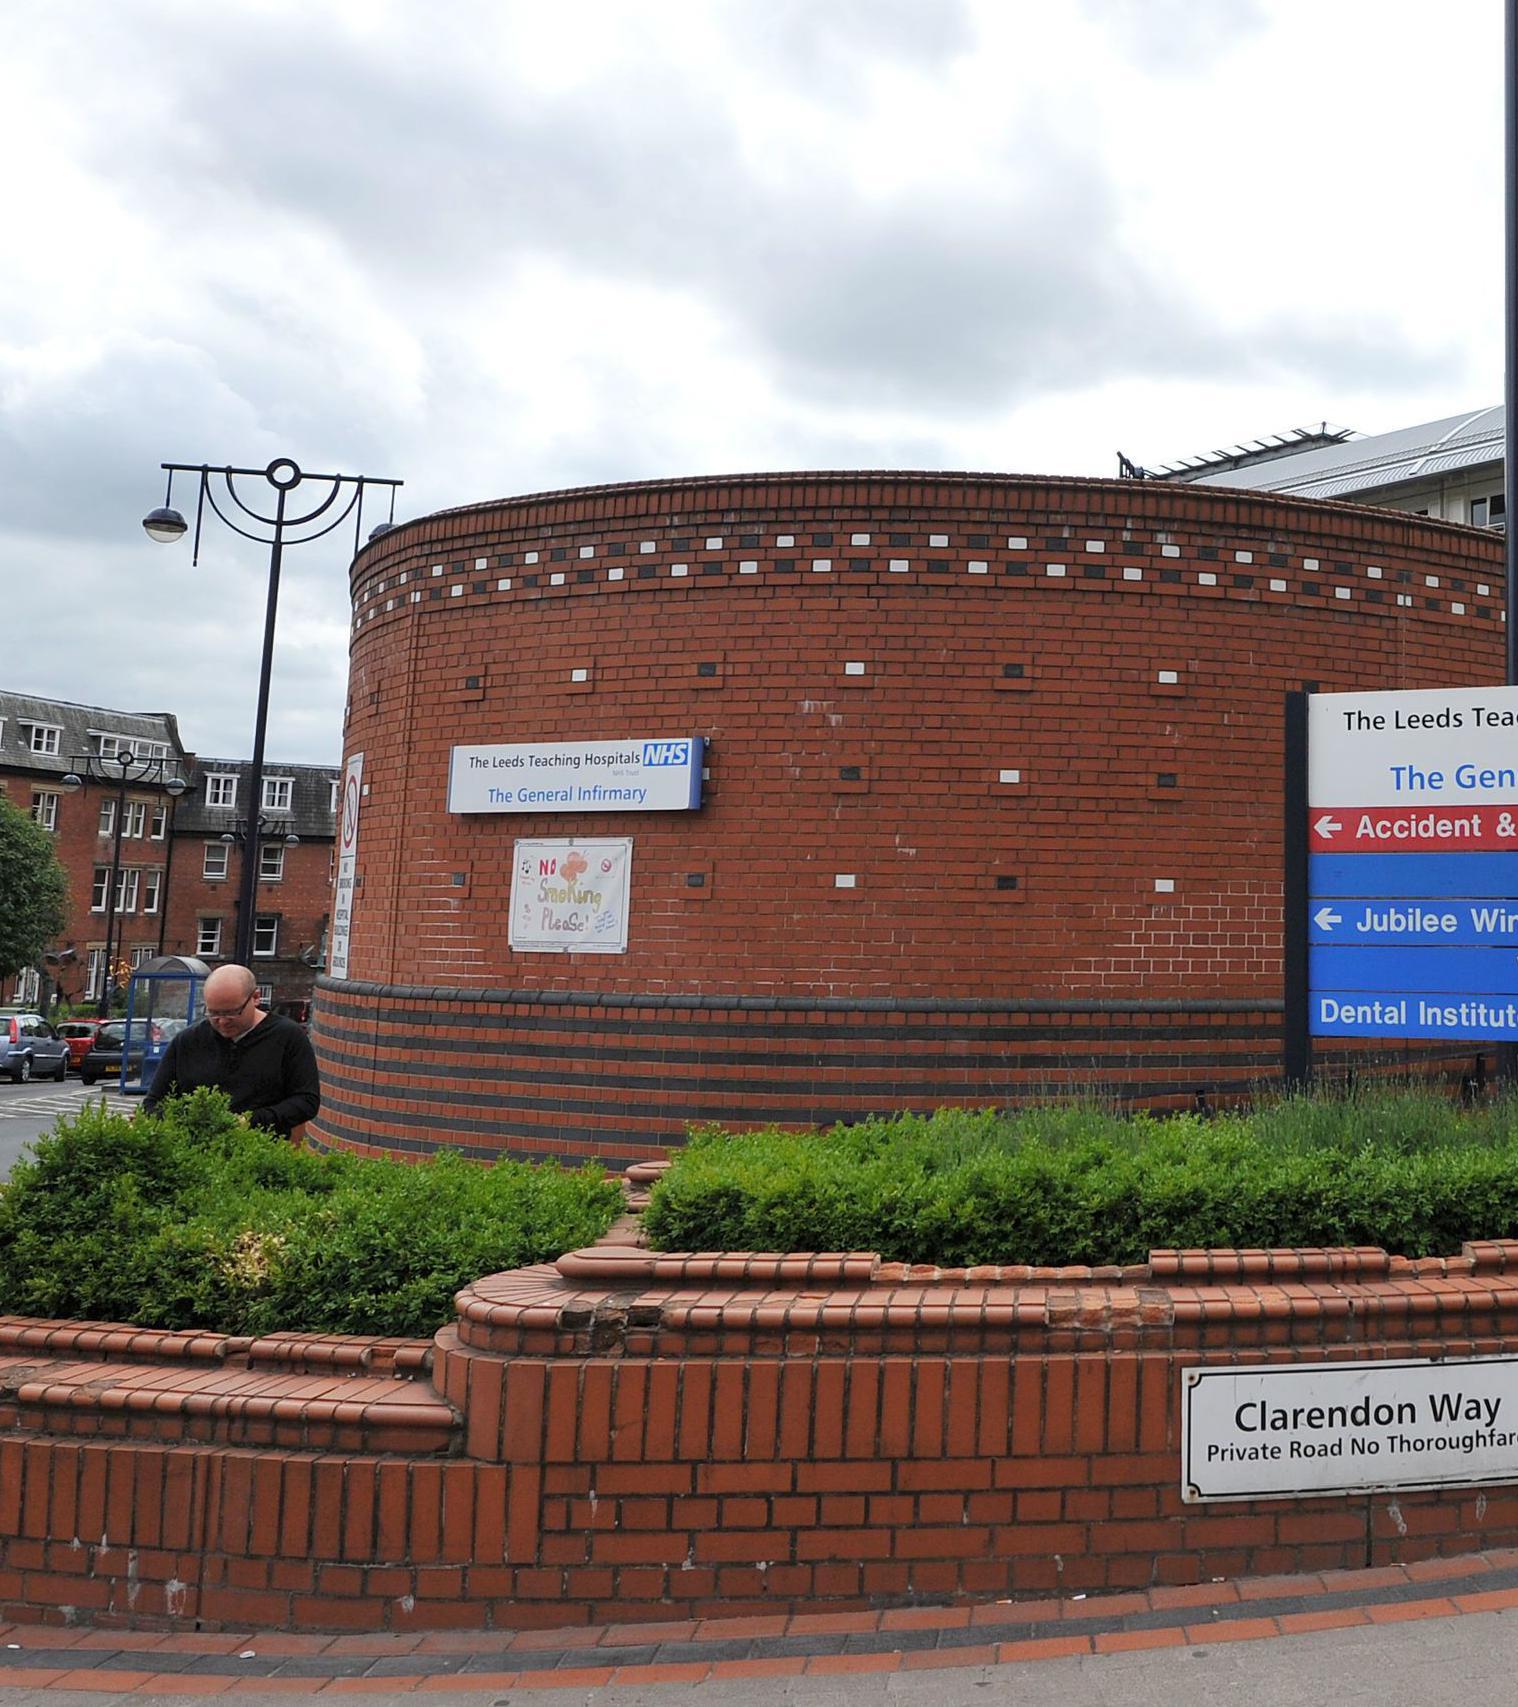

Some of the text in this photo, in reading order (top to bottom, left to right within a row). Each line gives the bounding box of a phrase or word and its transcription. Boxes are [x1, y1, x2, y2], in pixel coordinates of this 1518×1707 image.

[1343, 710, 1386, 731] The
[1394, 708, 1463, 730] Leeds
[469, 744, 688, 770] The Leeds Teaching Hospitals NHS
[1390, 764, 1444, 791] The
[488, 785, 647, 804] The General Infirmary
[1355, 814, 1482, 839] Accident
[1495, 812, 1517, 837] &
[1356, 907, 1458, 933] Jubilee
[1320, 998, 1406, 1025] Dental
[1235, 1393, 1502, 1432] Clarendon Way
[1207, 1442, 1282, 1462] Private
[1290, 1437, 1343, 1459] Road
[1351, 1437, 1380, 1455] No
